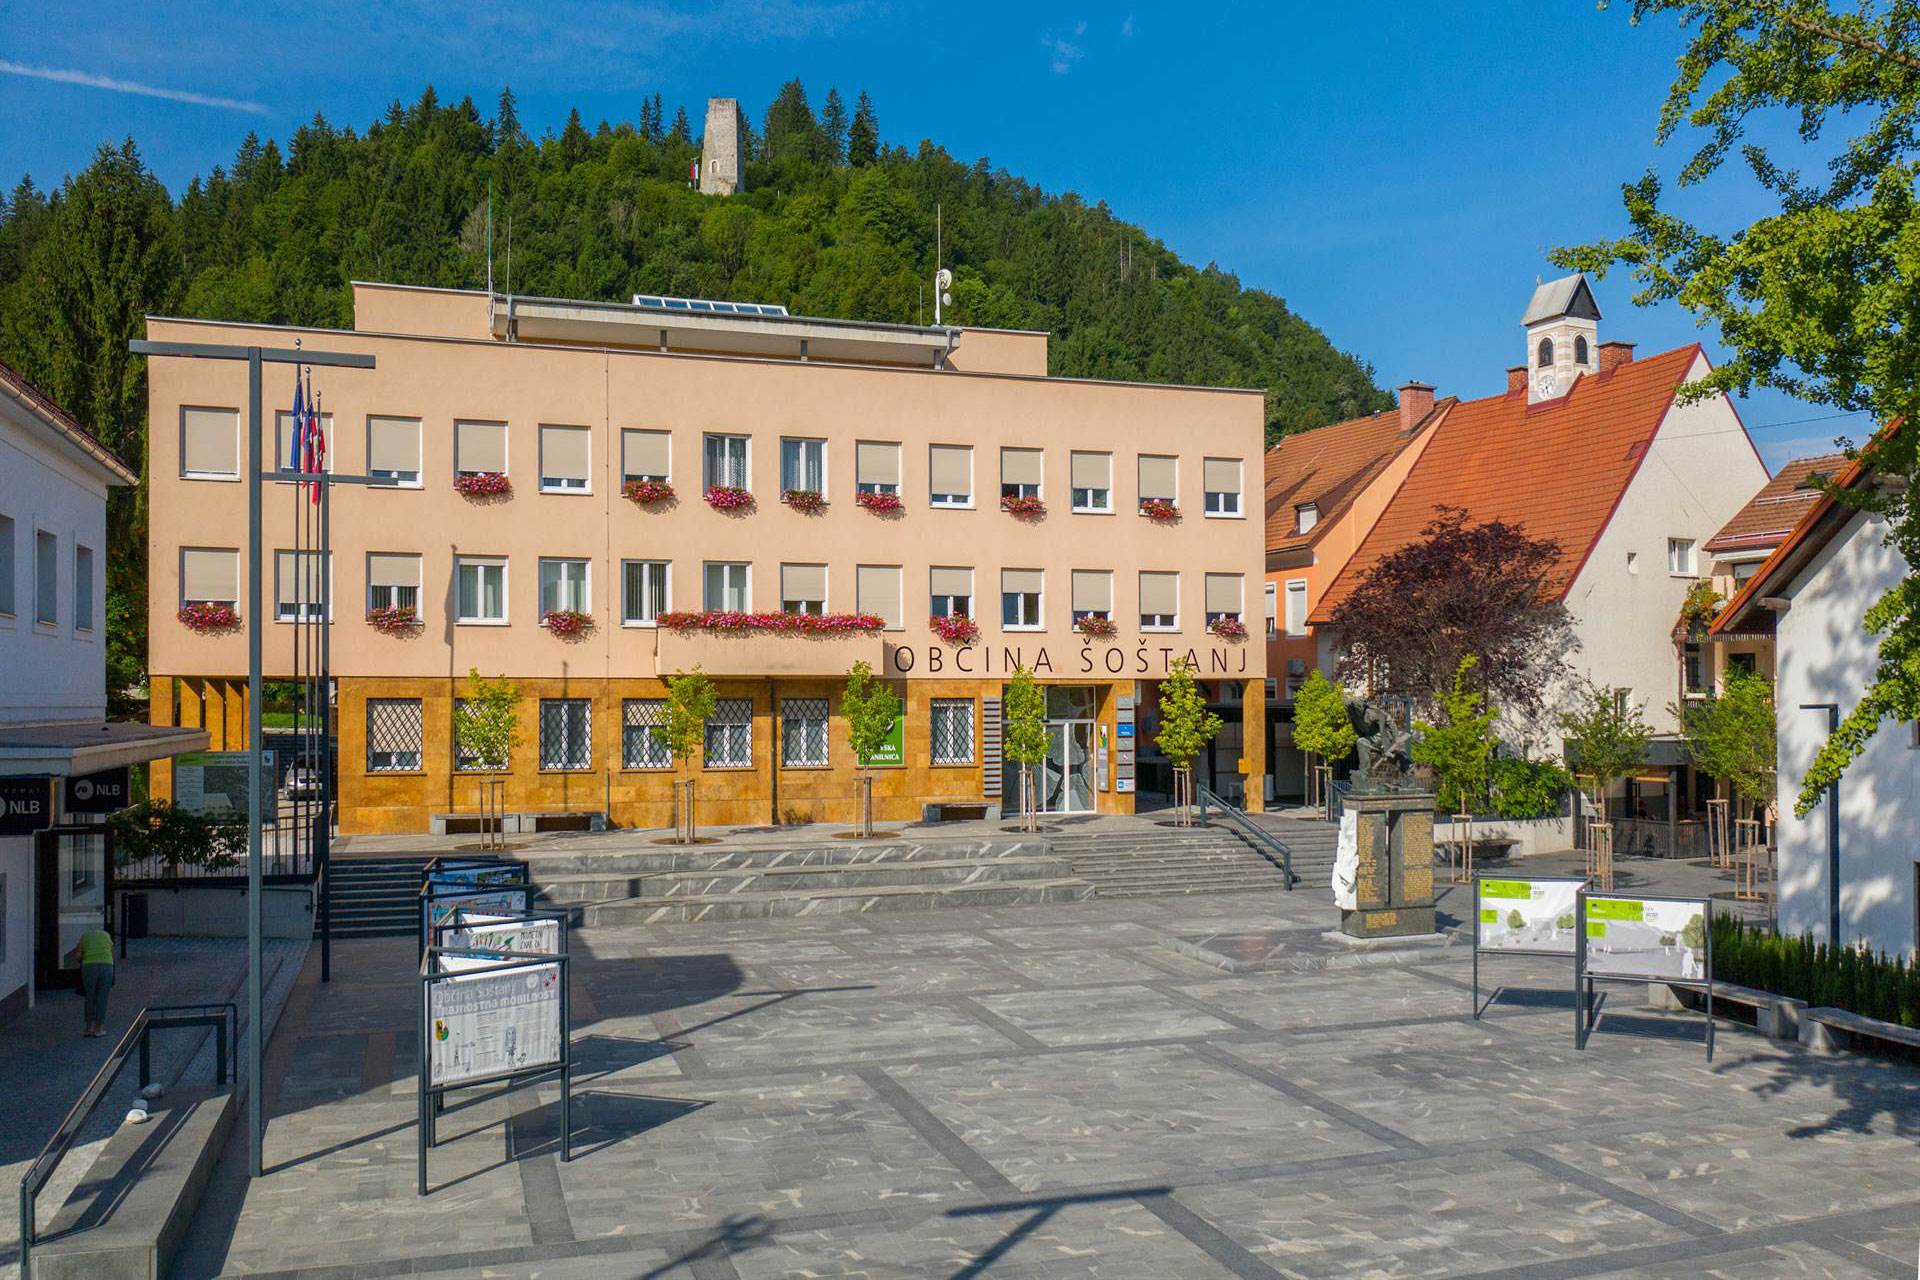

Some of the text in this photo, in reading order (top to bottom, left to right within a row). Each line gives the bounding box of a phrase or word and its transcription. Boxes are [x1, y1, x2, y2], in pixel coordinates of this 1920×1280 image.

[894, 638, 1246, 673] OBČINA ŠOŠTANJ
[97, 784, 121, 796] NLB
[9, 800, 40, 814] NLB
